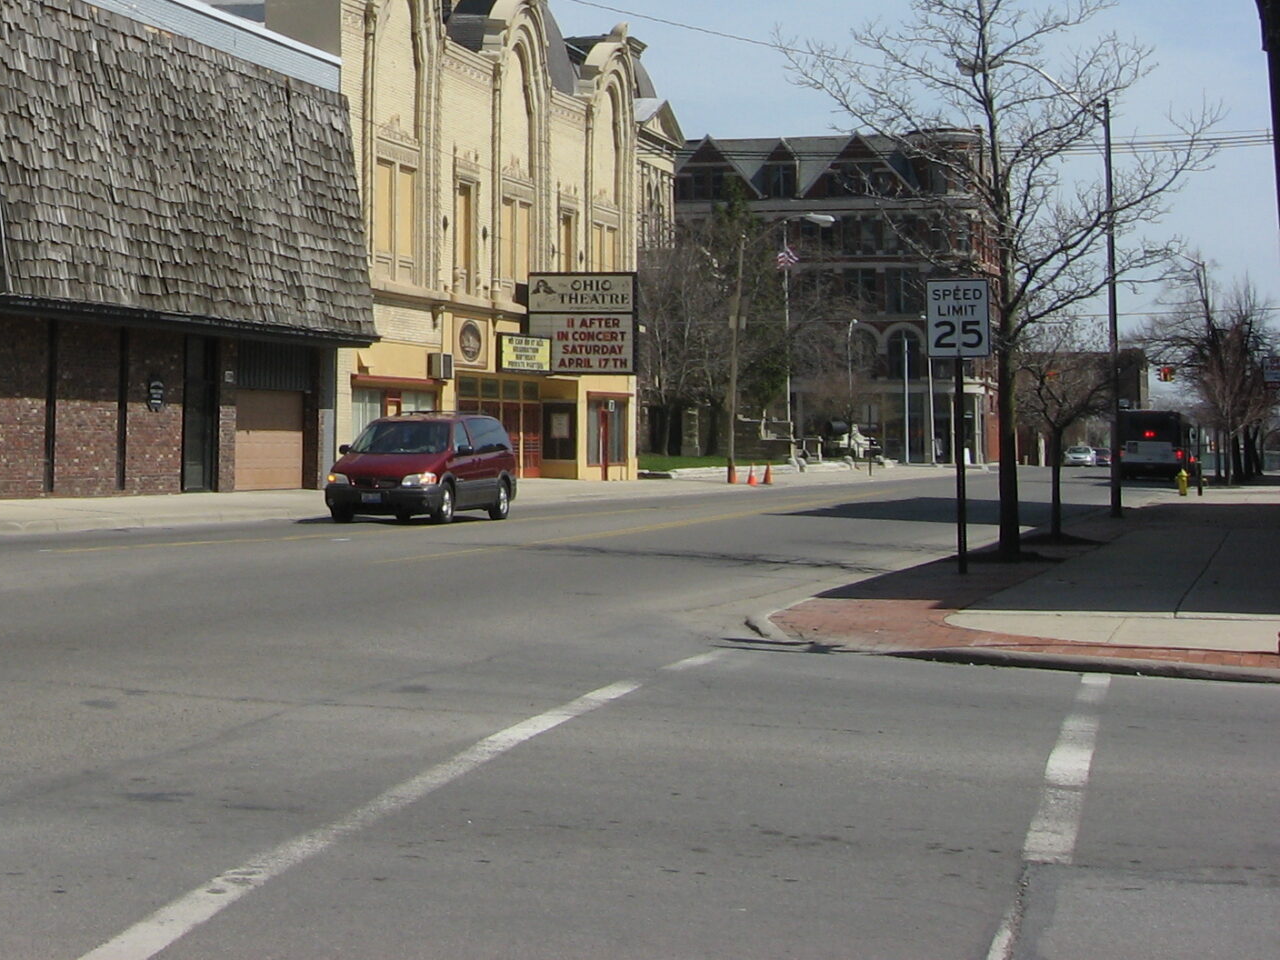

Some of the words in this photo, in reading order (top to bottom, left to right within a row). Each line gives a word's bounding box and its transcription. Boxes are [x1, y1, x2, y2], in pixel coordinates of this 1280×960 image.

[570, 279, 612, 291] OHIO
[558, 293, 630, 305] THEATRE
[932, 288, 982, 300] SPEED
[937, 304, 976, 316] LIMIT
[579, 318, 620, 328] AFTER
[556, 331, 569, 341] IN
[572, 331, 626, 342] CONCERT
[934, 320, 983, 348] 25
[562, 345, 624, 355] SATURDAY
[558, 358, 593, 368] APRIL
